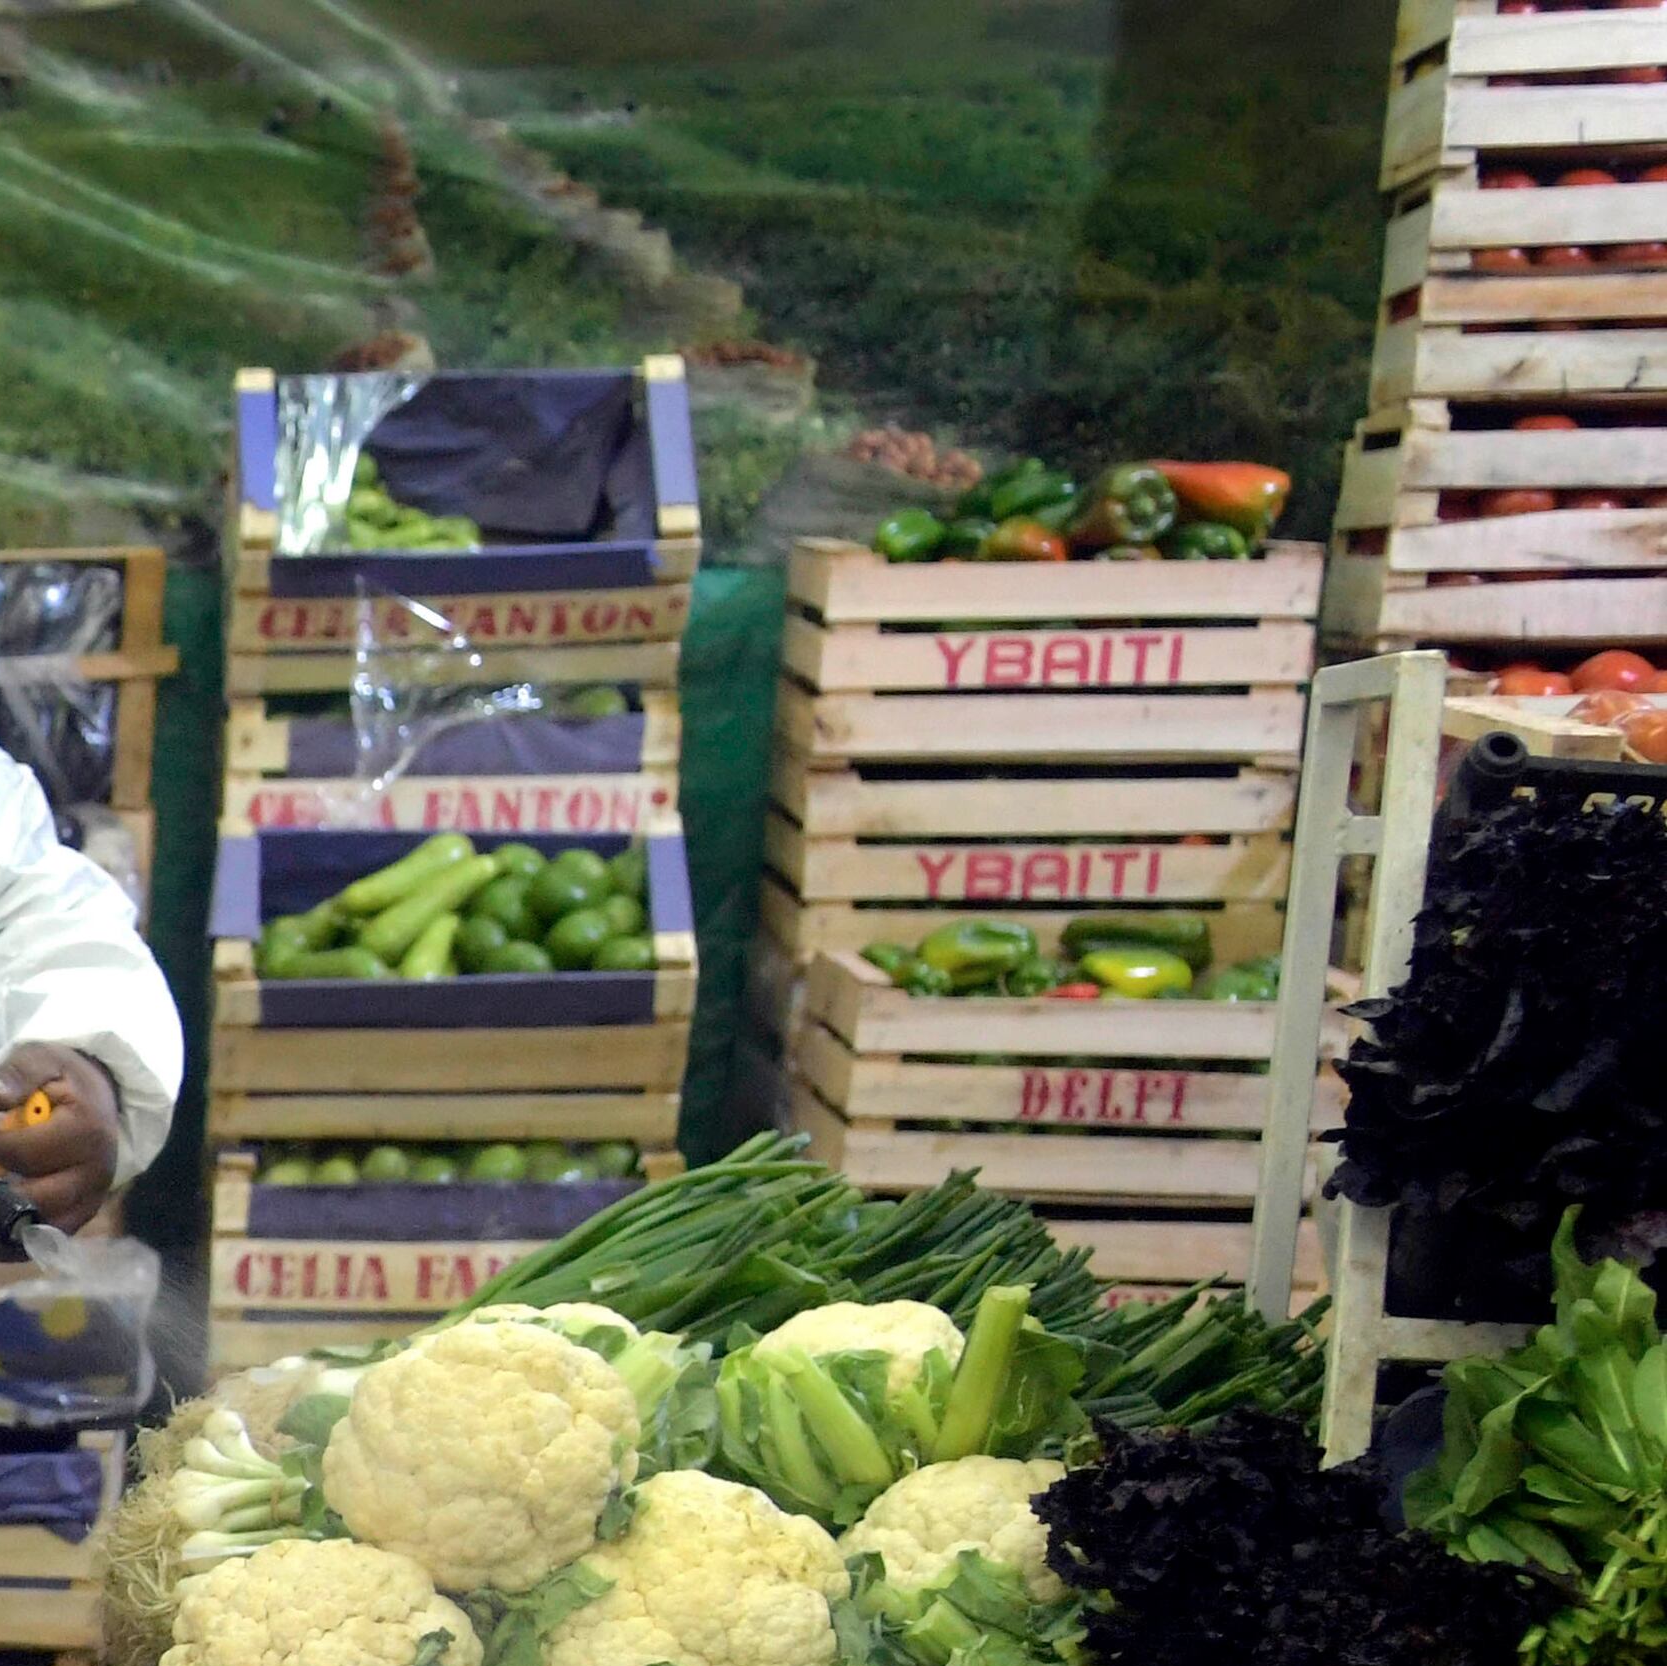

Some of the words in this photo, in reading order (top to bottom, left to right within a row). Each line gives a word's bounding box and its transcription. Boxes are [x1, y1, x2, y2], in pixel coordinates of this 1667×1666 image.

[935, 636, 1185, 686] YBAITI
[423, 788, 642, 831] FANTON
[915, 851, 1161, 901] YBAITI
[234, 1254, 387, 1299] CELIA
